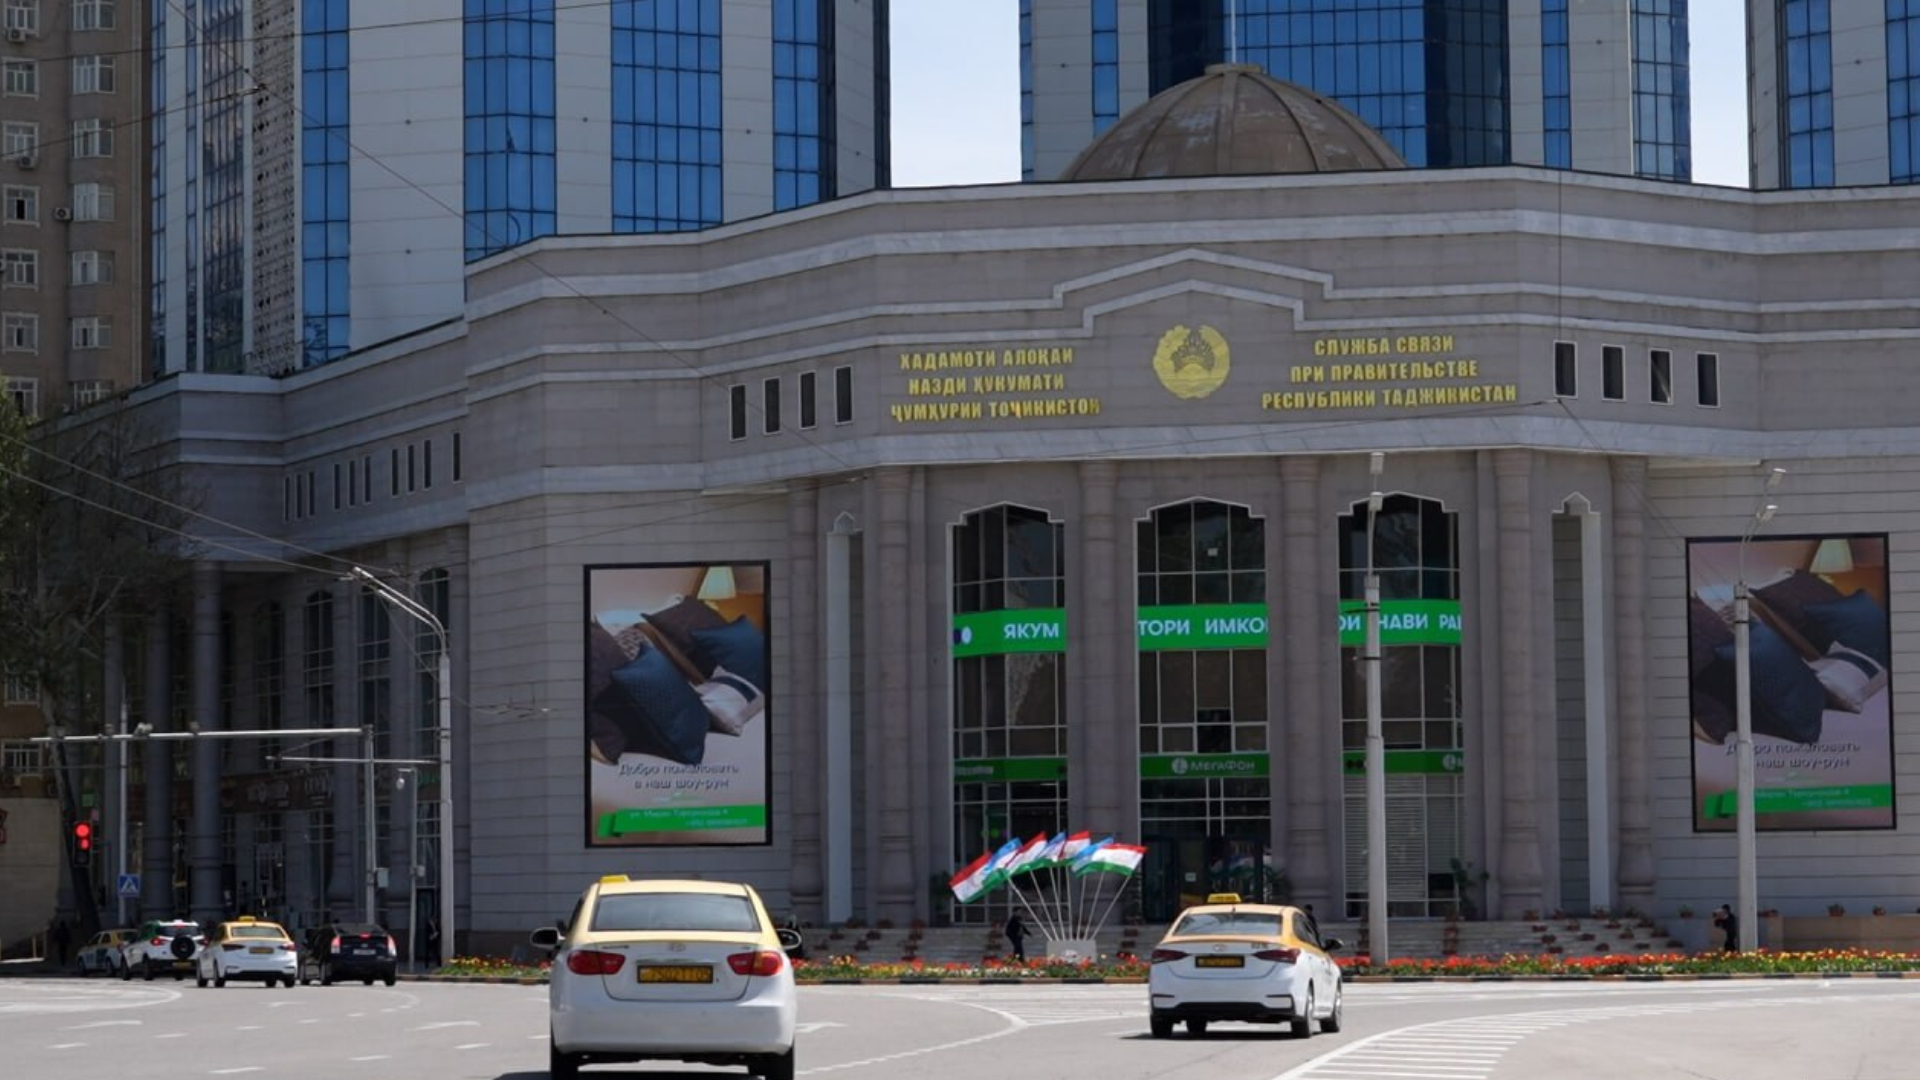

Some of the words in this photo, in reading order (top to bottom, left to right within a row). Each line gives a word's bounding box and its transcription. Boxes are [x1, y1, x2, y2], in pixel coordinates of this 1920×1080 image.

[1314, 337, 1390, 356] СЛУЖБА
[1396, 335, 1454, 353] СВЯЗИ
[900, 350, 996, 371] ХАДАМОТИ
[1290, 365, 1325, 383] ПРИ
[1331, 360, 1479, 382] ПРАВИТЕЛЬСТВЕ
[908, 377, 966, 397] НАЗДИ
[1262, 389, 1376, 410] РЕСПУБЛИКИ
[1382, 384, 1517, 408] ТАДЖИКИСТАН
[1003, 622, 1060, 640] ЯКУМ
[1205, 616, 1268, 635] ИМКО
